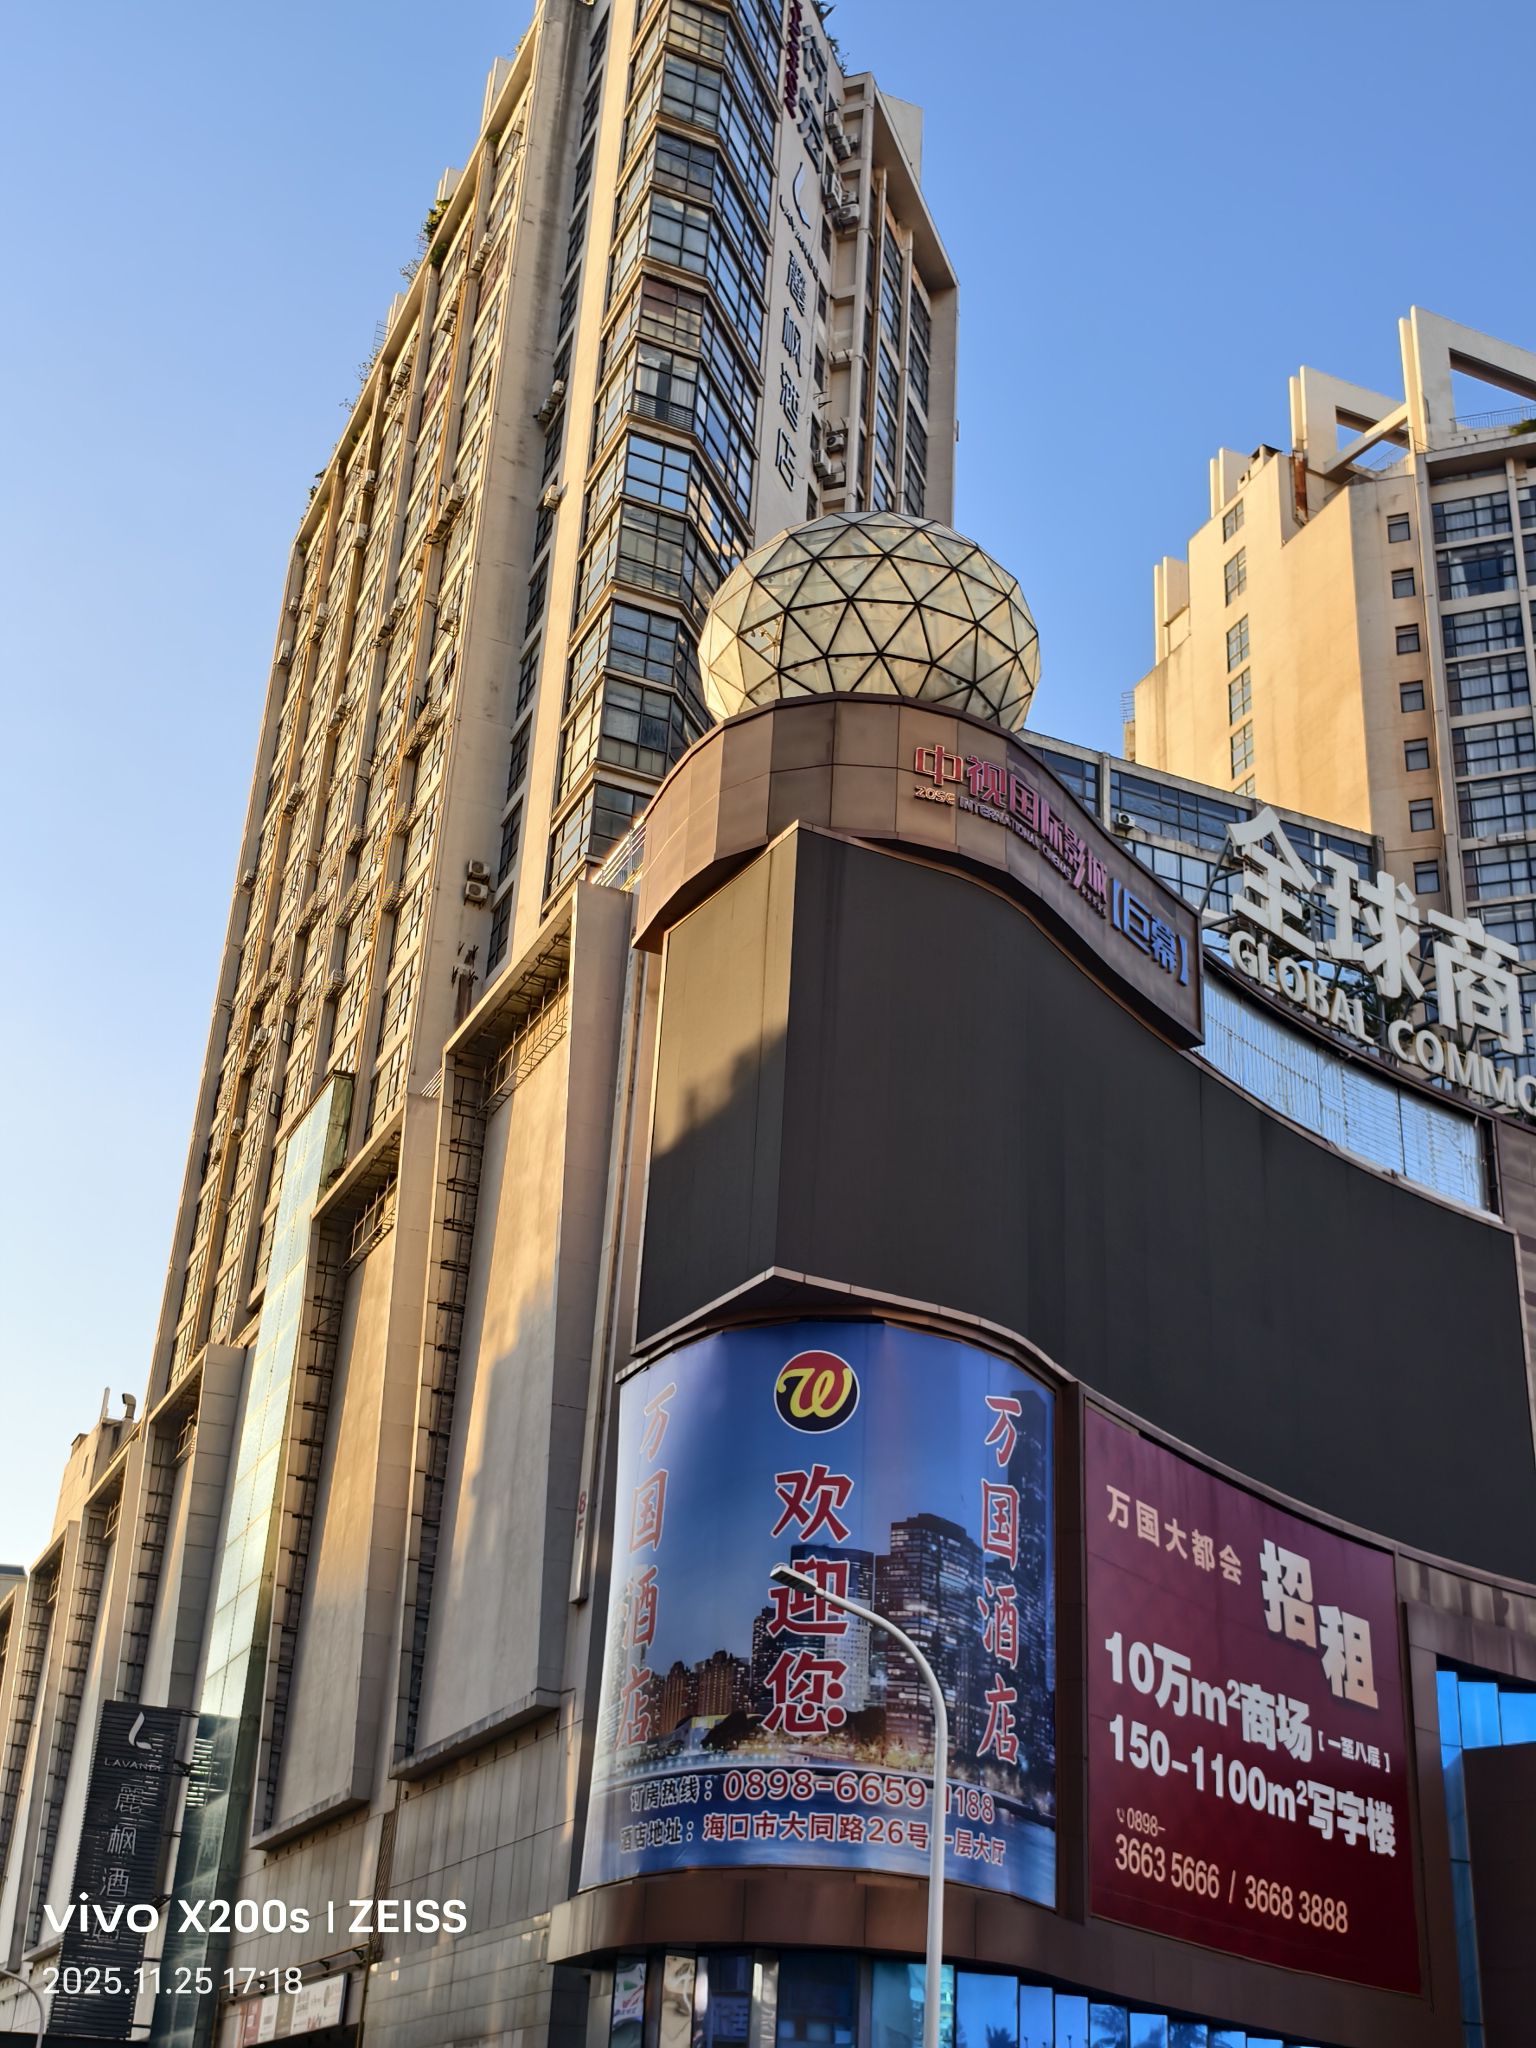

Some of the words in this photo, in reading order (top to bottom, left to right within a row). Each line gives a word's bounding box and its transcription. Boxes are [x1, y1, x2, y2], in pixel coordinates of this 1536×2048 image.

[915, 745, 1108, 904] 中视国际影城
[1229, 930, 1377, 1045] GLOBAL
[761, 1463, 854, 1734] 欢迎您
[976, 1395, 1022, 1765] 万国酒店
[1106, 1484, 1241, 1585] 万国大都会
[1260, 1538, 1378, 1709] 招租
[1115, 1833, 1166, 1882] 3663
[1171, 1852, 1220, 1899] 5666
[1245, 1874, 1293, 1920] 3668
[1298, 1890, 1348, 1934] 3888
